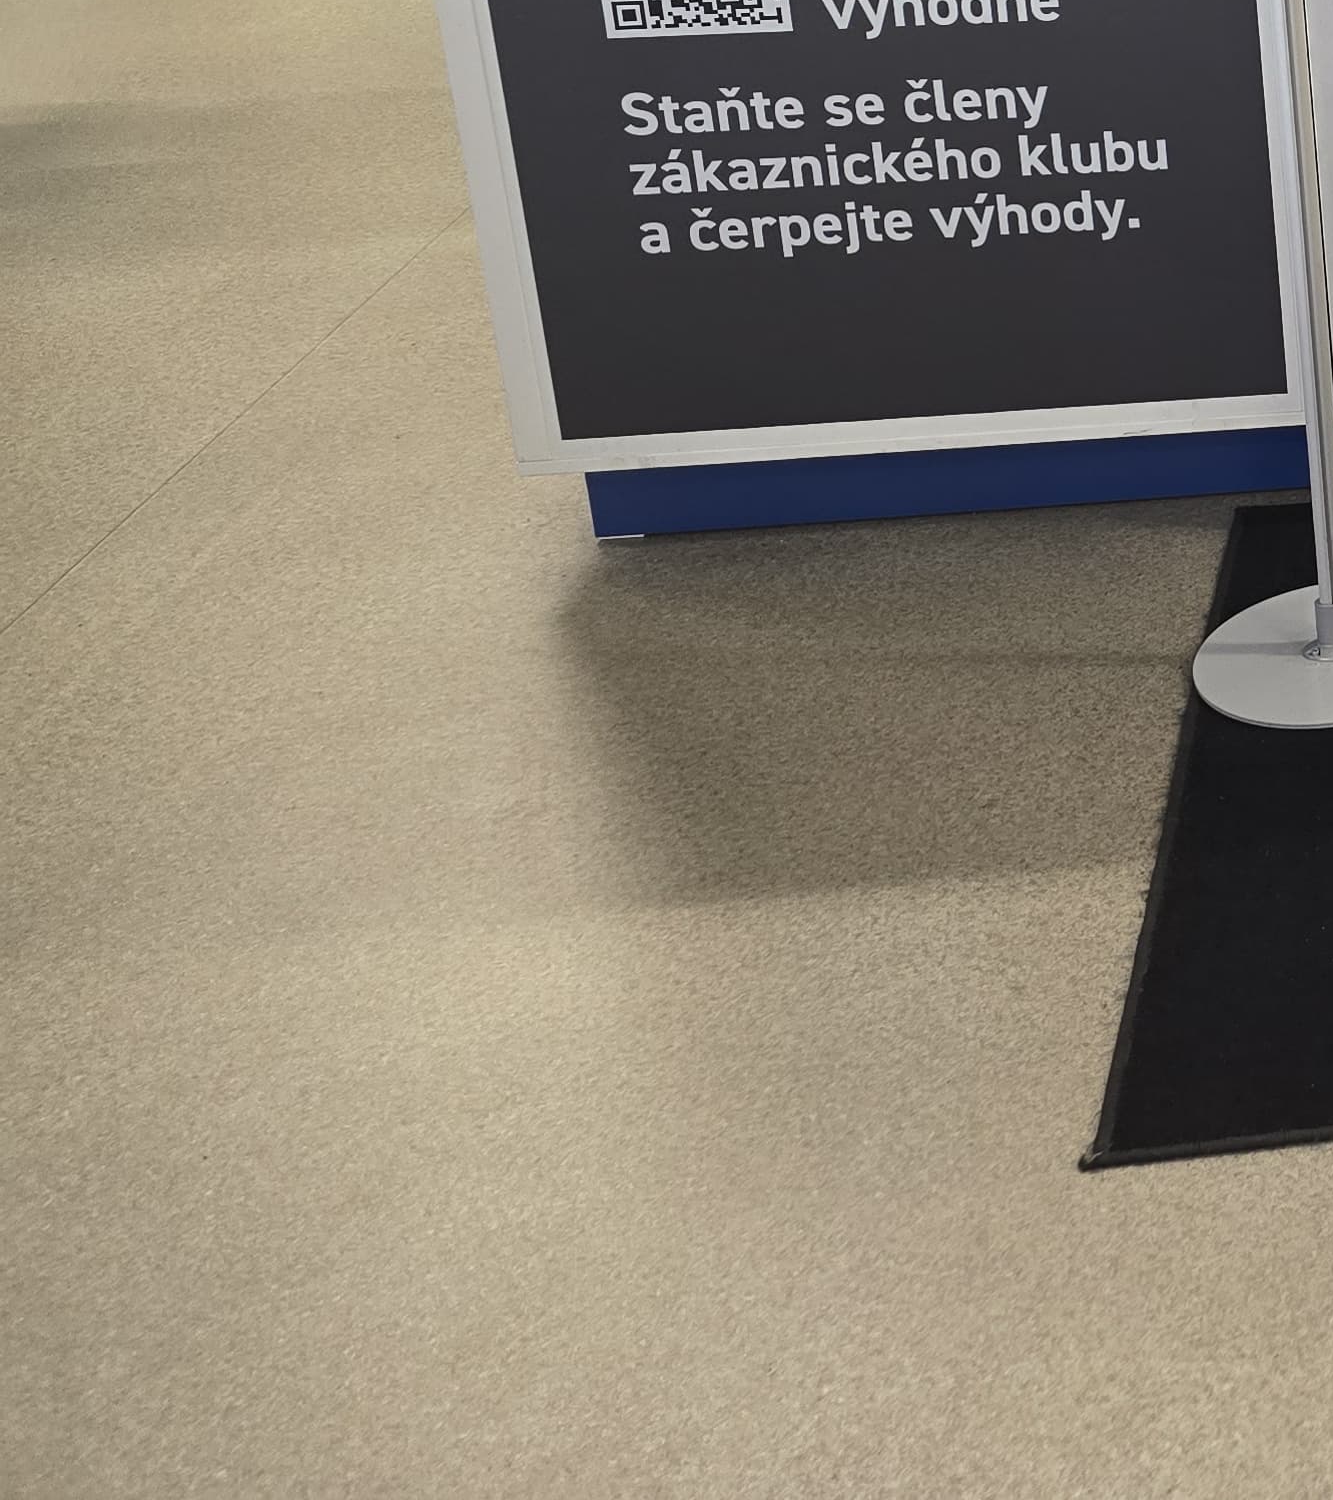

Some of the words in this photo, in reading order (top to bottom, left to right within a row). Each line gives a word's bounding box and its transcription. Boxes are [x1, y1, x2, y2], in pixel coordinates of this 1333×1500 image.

[620, 86, 805, 137] Staňte
[823, 93, 886, 128] se
[903, 79, 1048, 128] členy
[628, 136, 1002, 197] zákaznického
[1017, 130, 1169, 177] klubu
[639, 219, 672, 254] a
[688, 201, 914, 257] čerpejte
[929, 190, 1142, 248] výhody.
